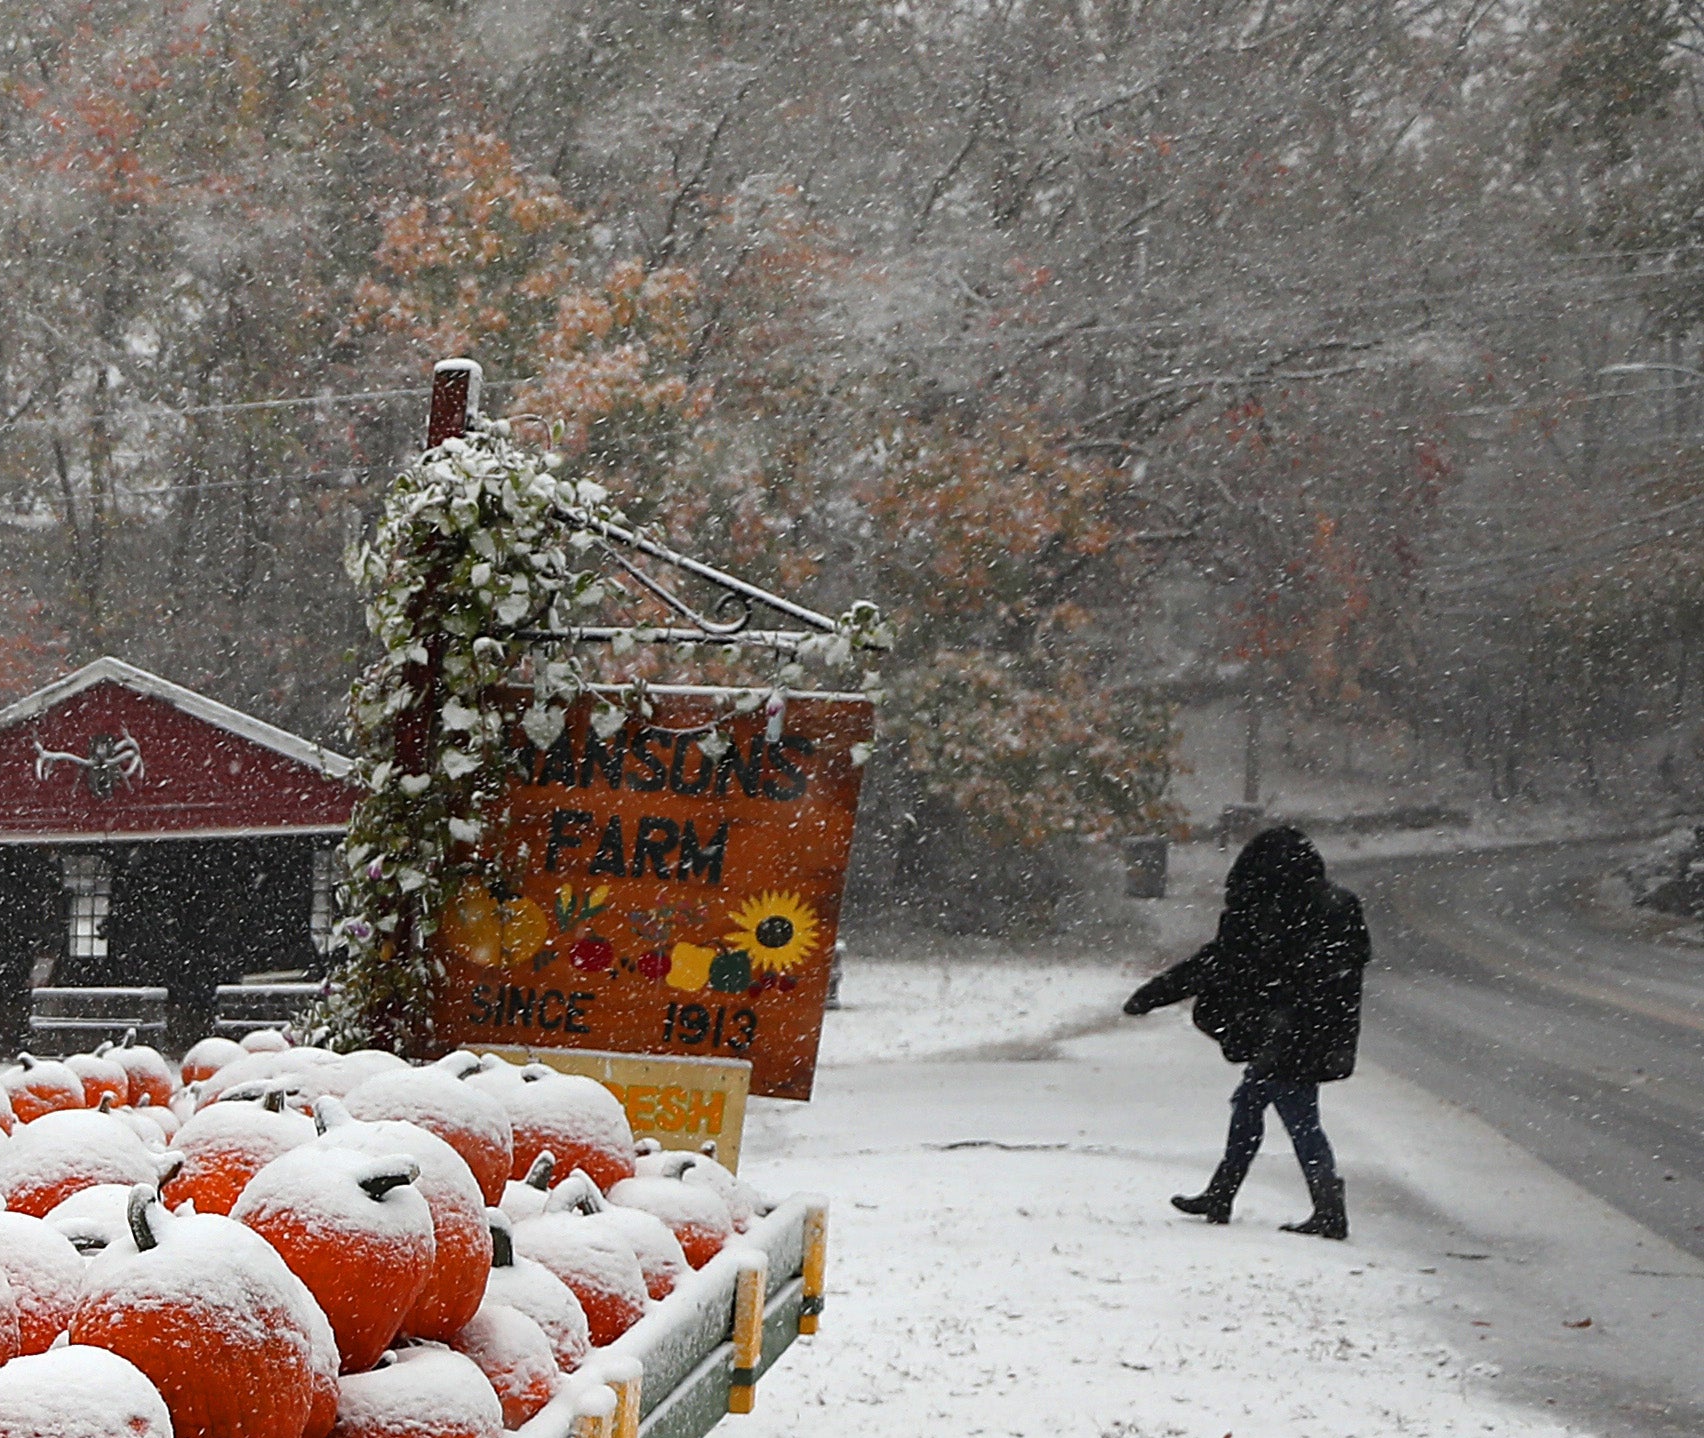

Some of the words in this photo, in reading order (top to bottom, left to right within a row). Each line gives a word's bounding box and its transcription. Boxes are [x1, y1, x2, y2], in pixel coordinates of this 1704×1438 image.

[544, 807, 729, 884] FARM
[468, 983, 596, 1034] SINCE
[662, 1002, 759, 1050] 1913
